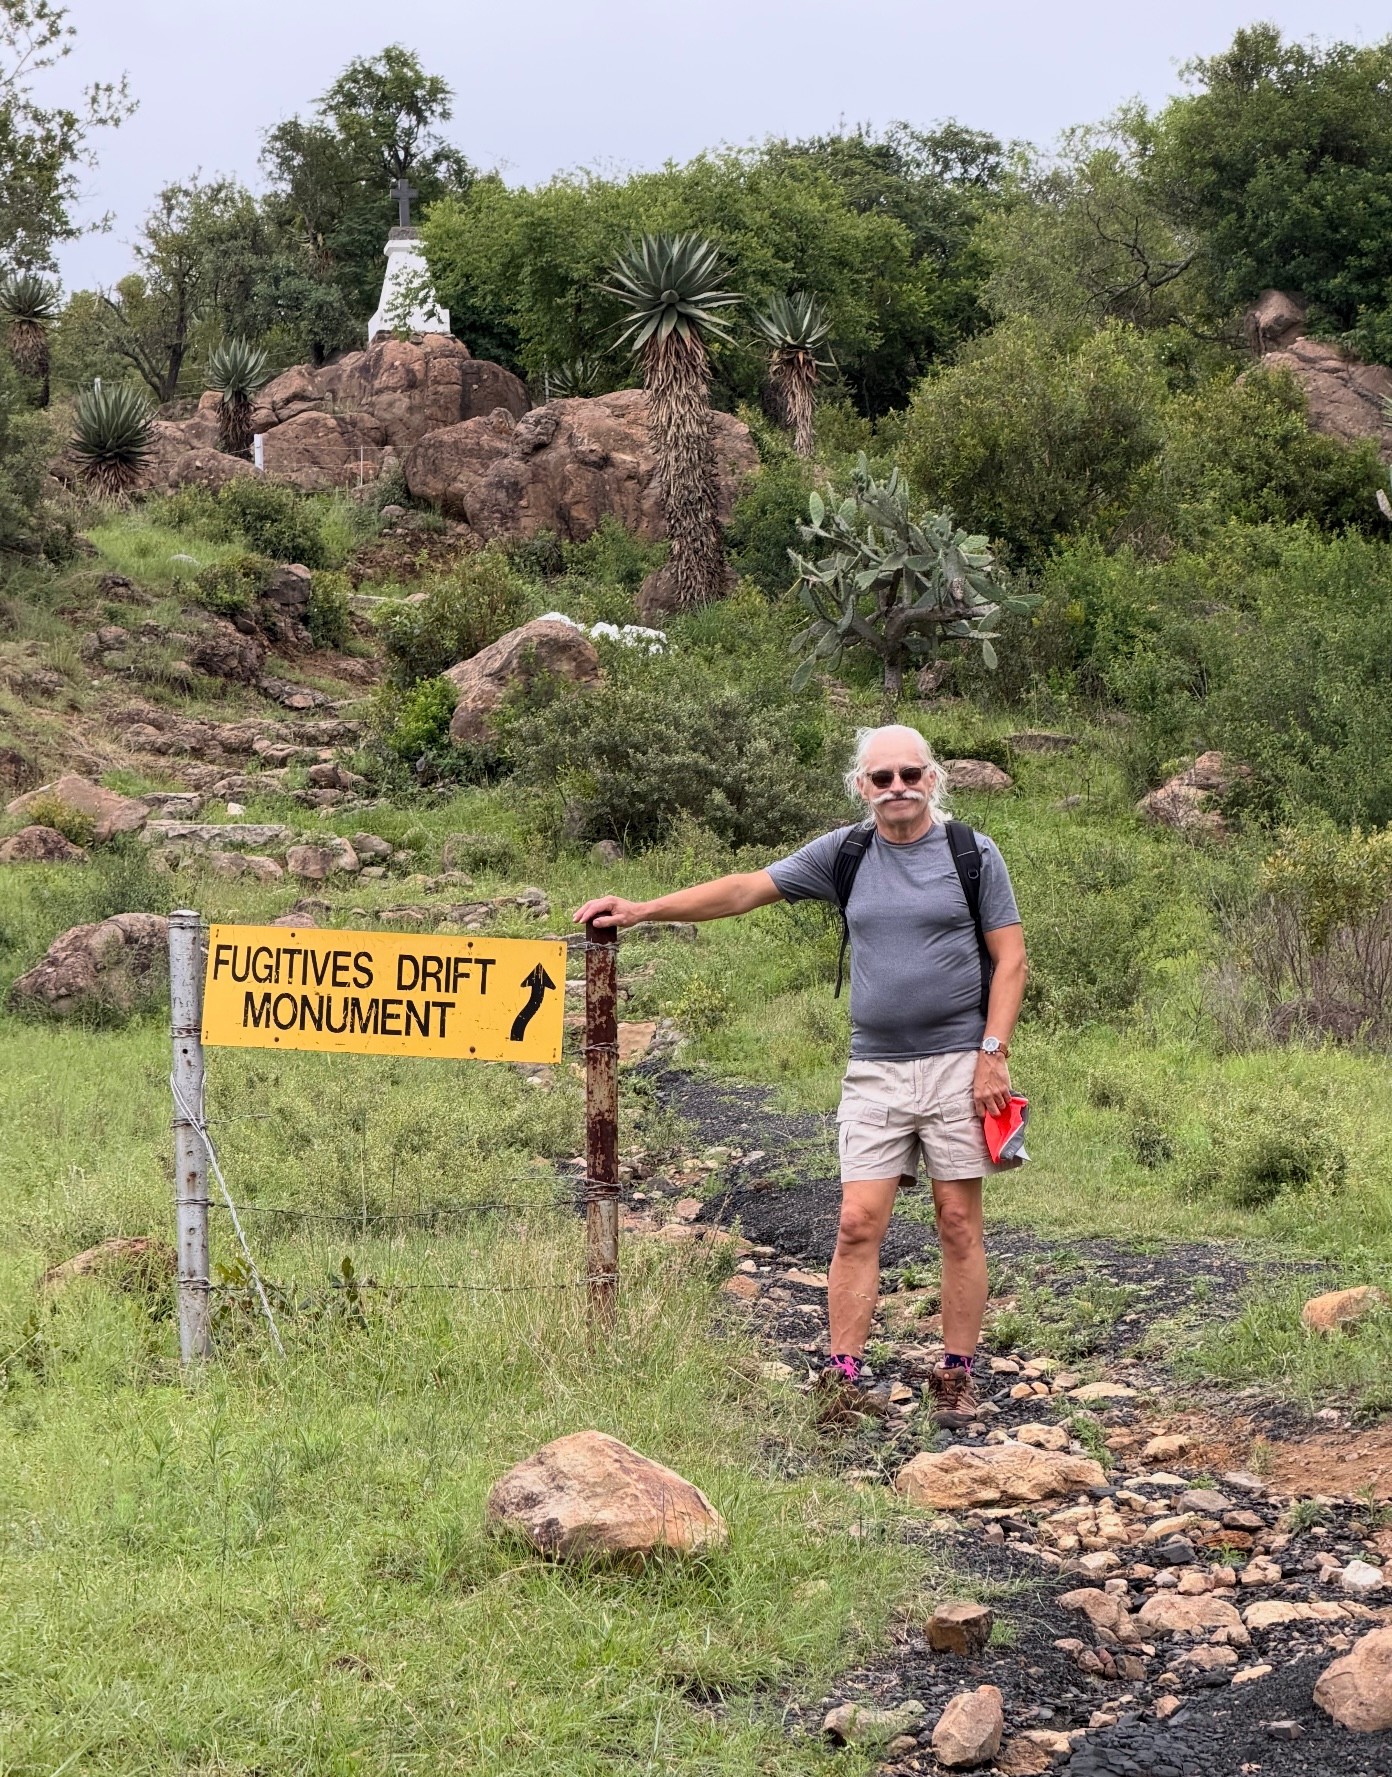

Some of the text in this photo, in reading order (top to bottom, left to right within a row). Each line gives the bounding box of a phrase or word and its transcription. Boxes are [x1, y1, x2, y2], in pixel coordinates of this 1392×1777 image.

[213, 944, 496, 995] FUGITIVES DRIFT
[242, 991, 456, 1038] MONUMENT
